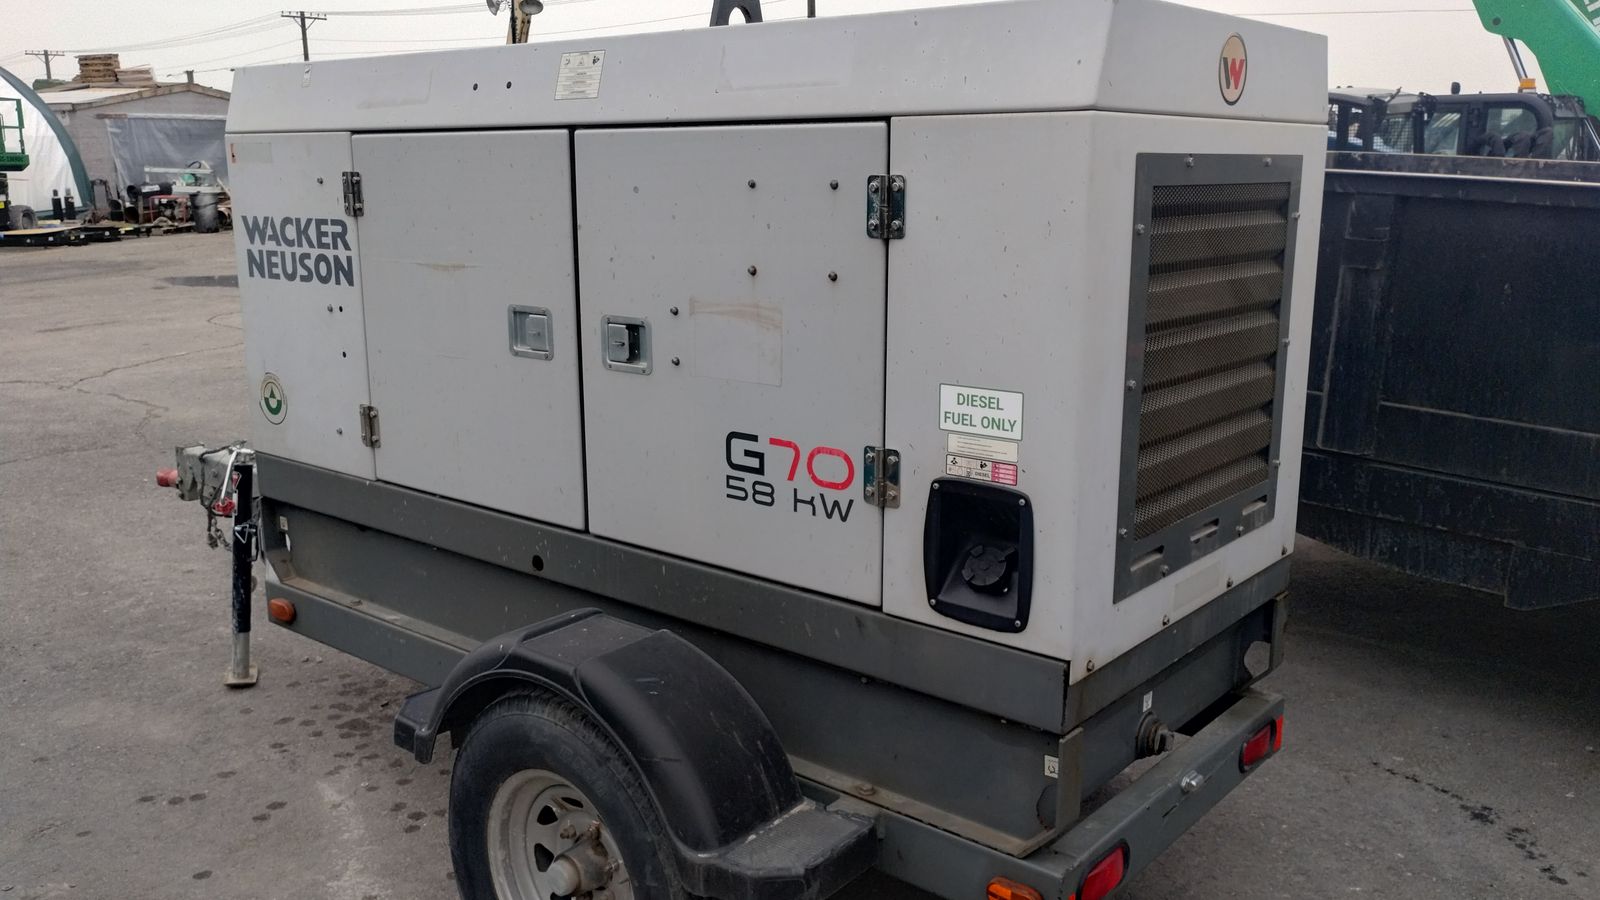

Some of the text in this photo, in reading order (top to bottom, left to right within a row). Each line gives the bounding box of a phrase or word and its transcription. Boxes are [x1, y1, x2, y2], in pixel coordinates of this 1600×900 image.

[241, 215, 352, 251] WACKER
[246, 249, 355, 287] NEUSON
[957, 393, 1004, 411] DIESEL
[944, 411, 1017, 432] FUEL ONLY
[726, 431, 855, 490] G70
[726, 475, 854, 523] 58 kW
